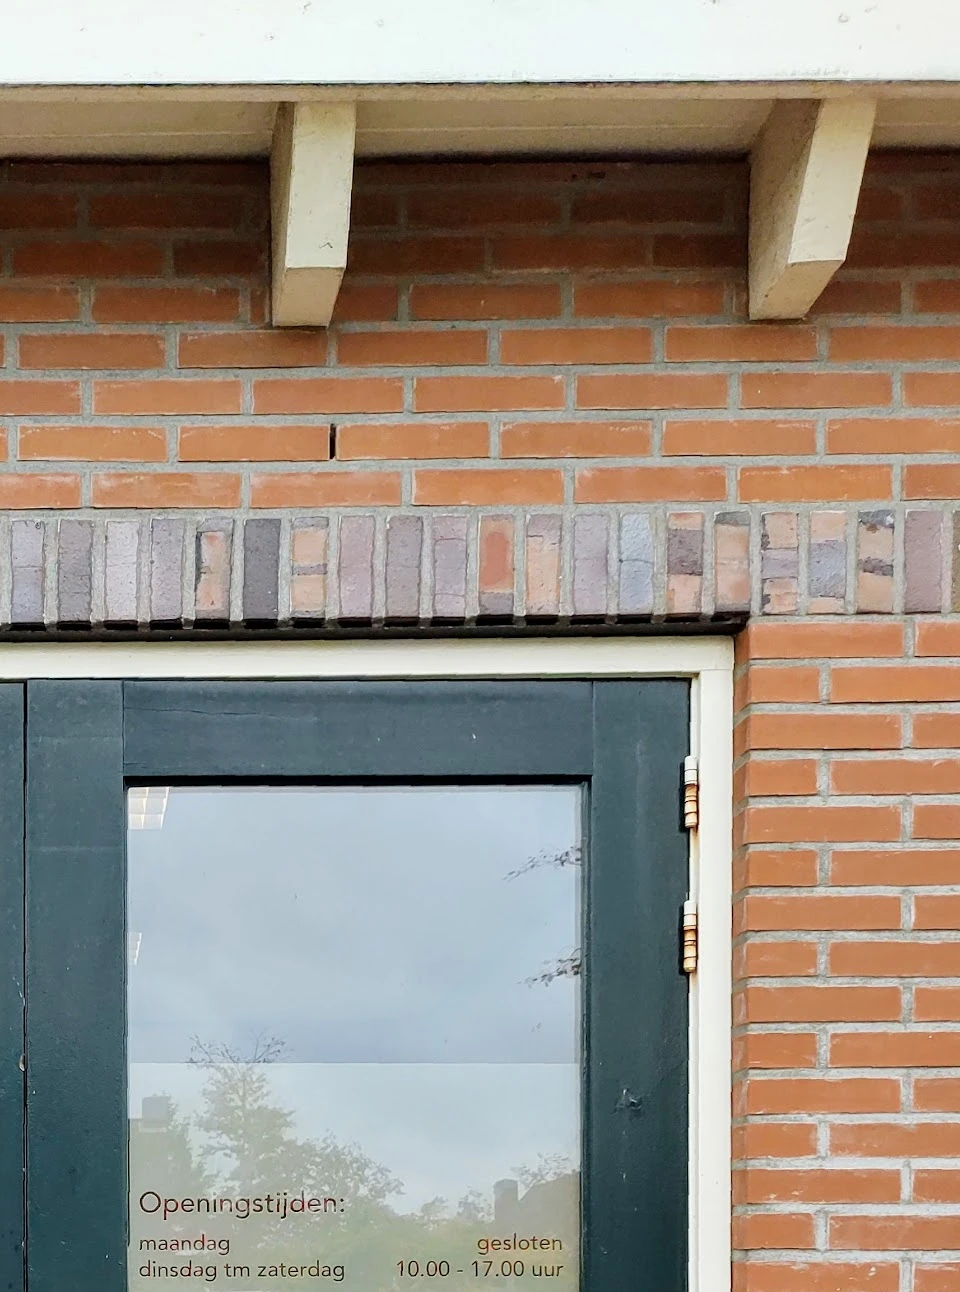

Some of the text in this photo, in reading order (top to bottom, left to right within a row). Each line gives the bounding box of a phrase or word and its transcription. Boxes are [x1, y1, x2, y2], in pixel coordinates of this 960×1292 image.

[139, 1190, 346, 1221] Openingstijden:
[139, 1233, 563, 1254] maandag gesloten
[138, 1260, 217, 1280] dinsdag
[223, 1264, 251, 1279] tm
[257, 1260, 345, 1281] zaterdag
[397, 1260, 451, 1278] 10.00
[472, 1260, 525, 1278] 17.00
[531, 1263, 564, 1278] uur
